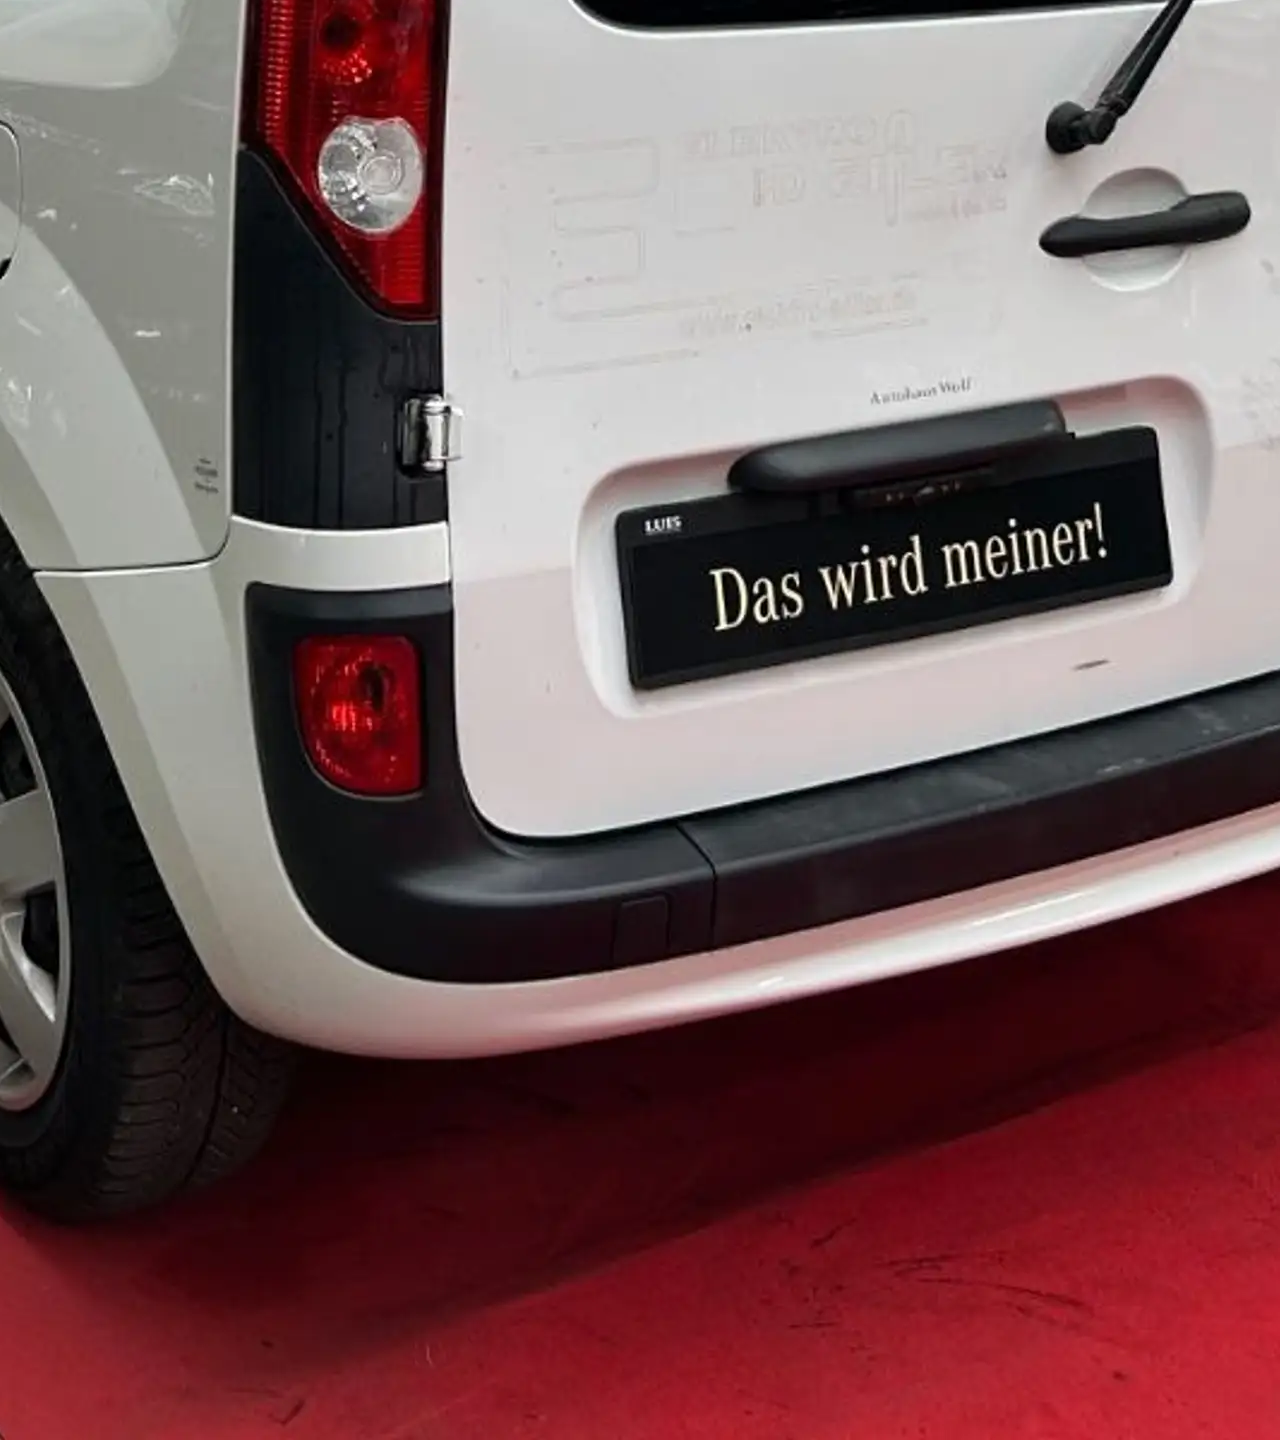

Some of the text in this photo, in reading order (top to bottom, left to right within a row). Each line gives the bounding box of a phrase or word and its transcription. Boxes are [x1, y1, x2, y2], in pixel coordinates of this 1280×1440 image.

[709, 501, 1109, 631] Das wird meiner!
